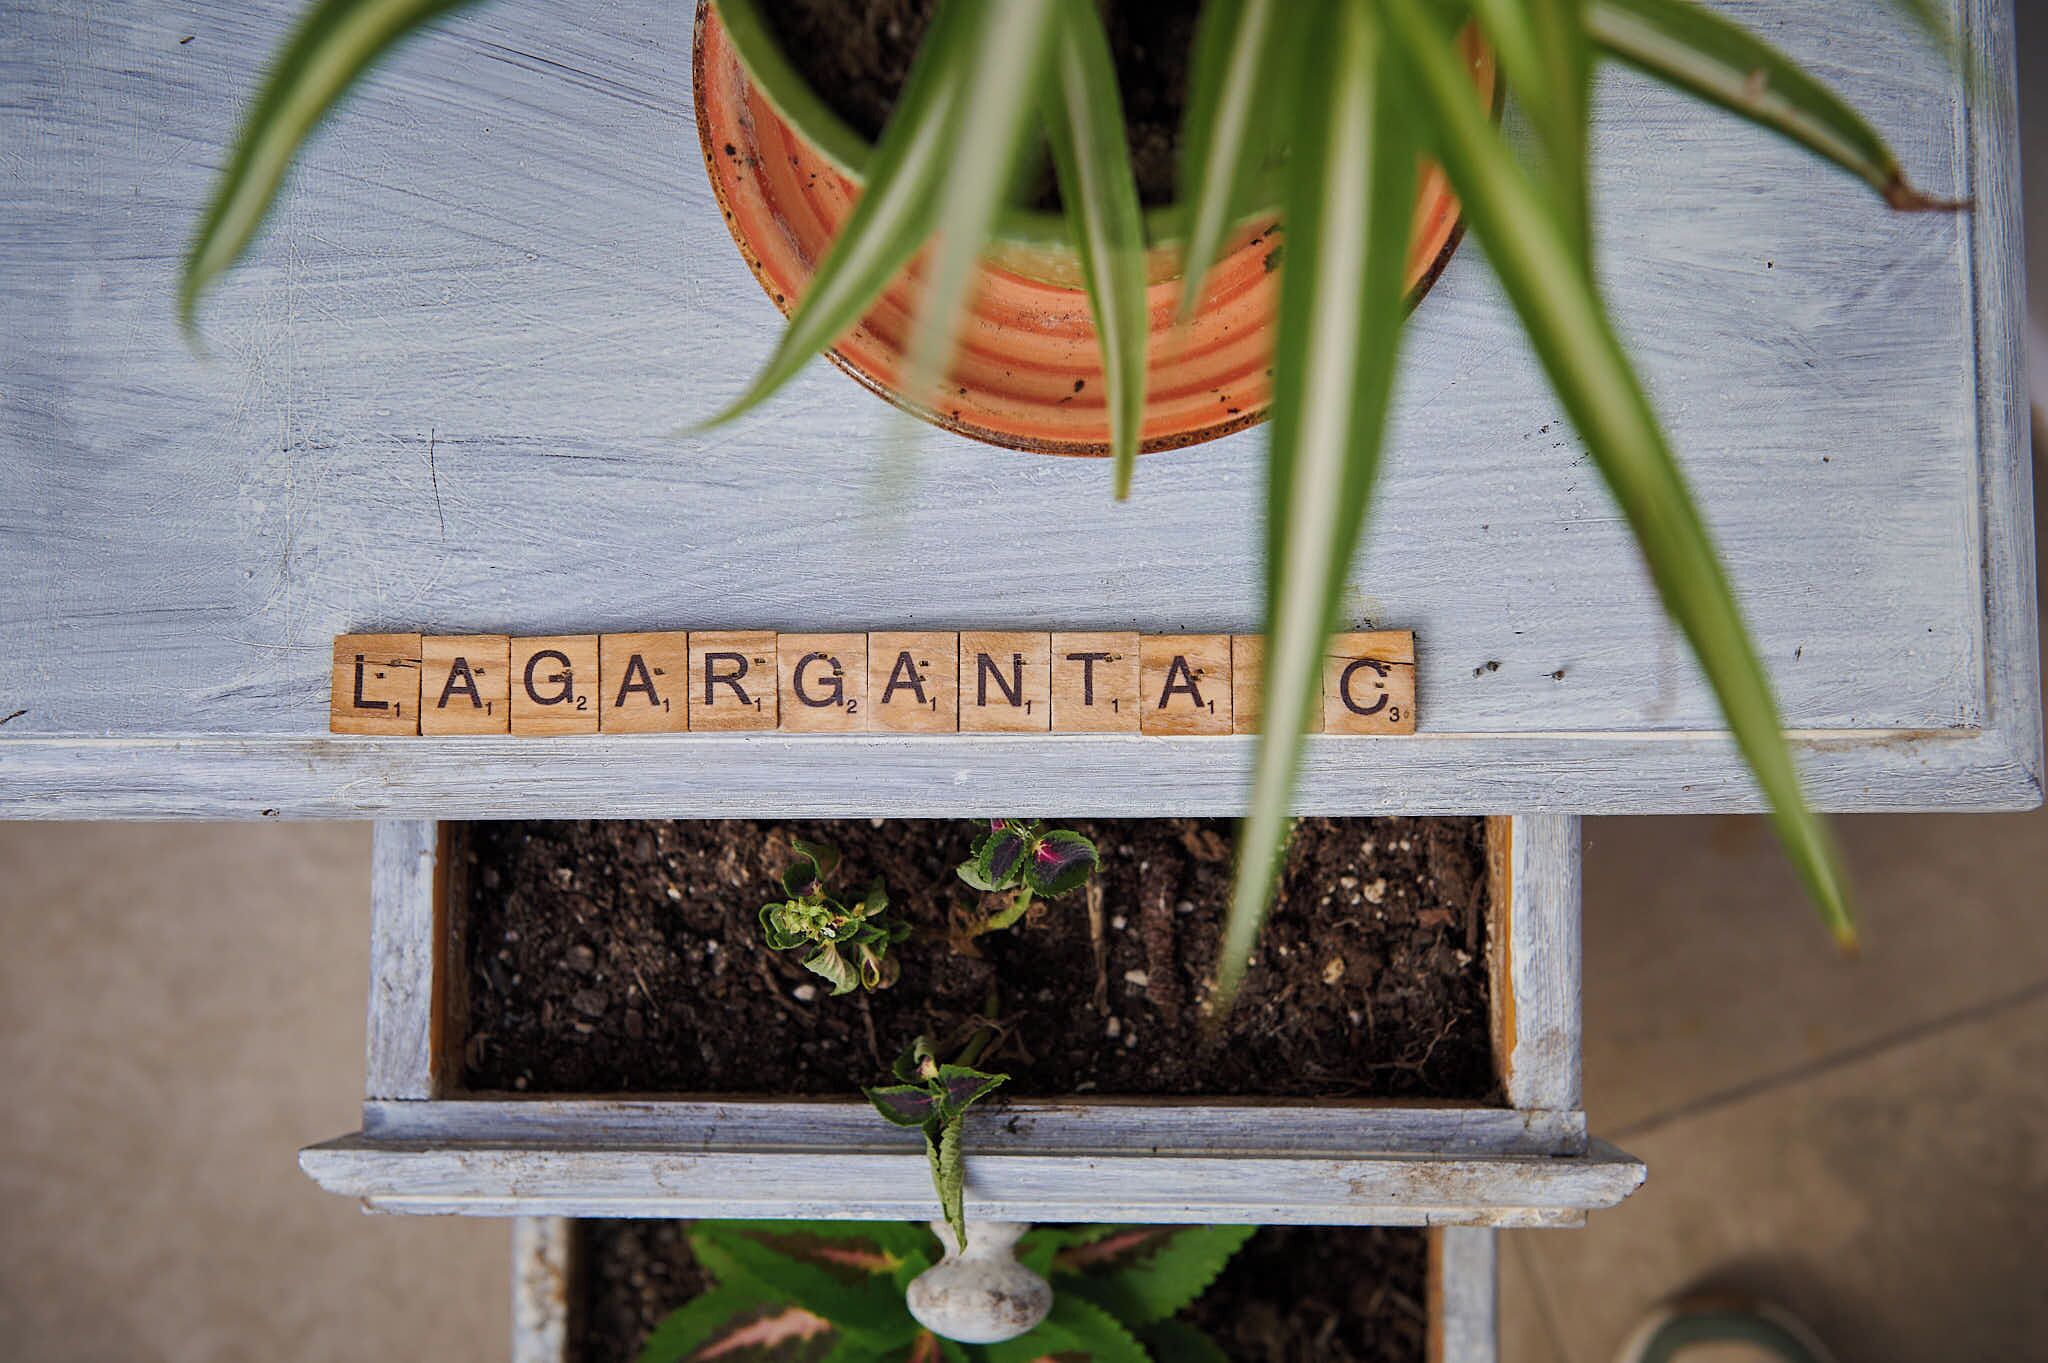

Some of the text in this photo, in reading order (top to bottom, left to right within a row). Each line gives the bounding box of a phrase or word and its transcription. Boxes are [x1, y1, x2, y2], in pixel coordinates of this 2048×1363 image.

[394, 702, 400, 717] 1
[486, 702, 493, 716] 1
[576, 696, 587, 711] 2
[662, 699, 670, 713] 1
[753, 698, 761, 712] 1
[846, 699, 857, 714] 2
[929, 696, 936, 711] 1
[1024, 699, 1032, 715] 1
[1111, 698, 1119, 713] 1
[1207, 699, 1214, 714] 1
[1389, 706, 1400, 722] 3
